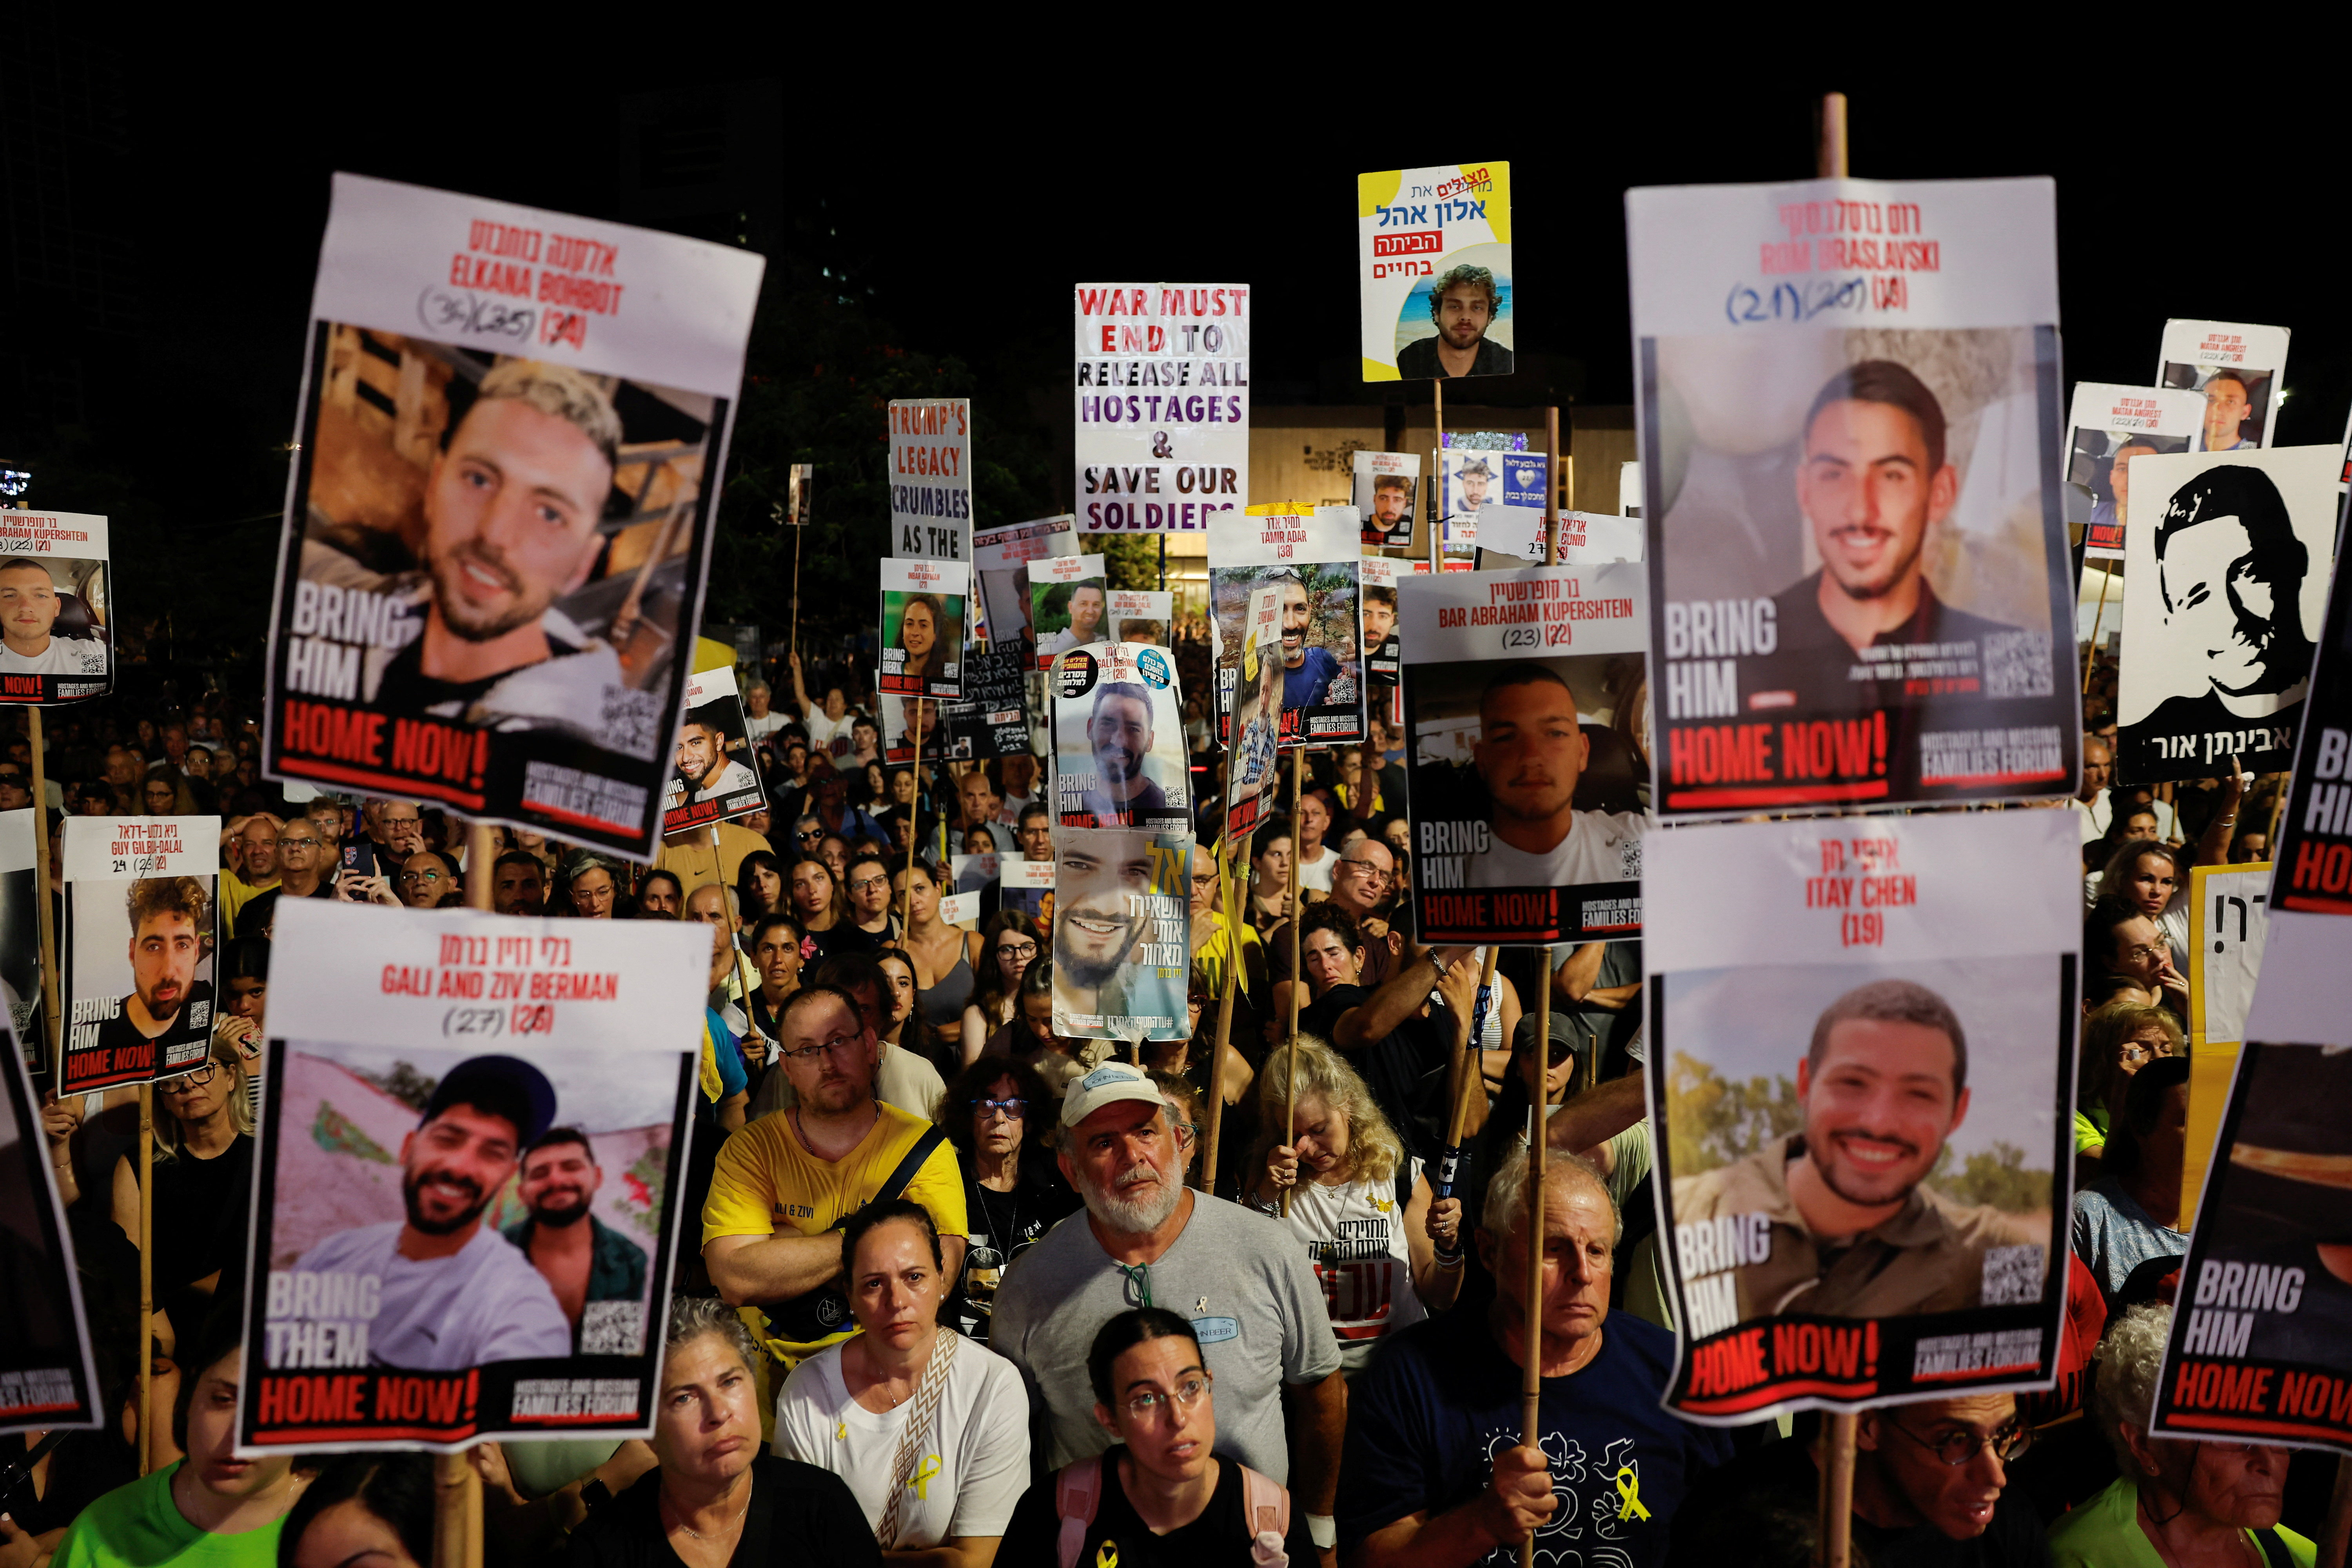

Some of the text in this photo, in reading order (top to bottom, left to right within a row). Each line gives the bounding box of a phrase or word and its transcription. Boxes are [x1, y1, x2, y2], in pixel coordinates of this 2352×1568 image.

[1437, 167, 1490, 197] מצילים
[1376, 199, 1486, 228] אלון אהל
[1378, 235, 1437, 253] הביתה
[1760, 240, 1939, 274] ROM BRASLAVSKI
[1374, 261, 1433, 278] בחיים
[450, 254, 625, 317] ELKANA BOHBOT
[1079, 289, 1246, 316] WAR MUST
[1102, 325, 1223, 352] END TO
[1078, 362, 1247, 386] RELEASE ALL
[890, 402, 966, 436] TRUMP'S
[1083, 395, 1241, 423] HOSTAGES
[1153, 431, 1173, 458] &
[898, 446, 960, 476] LEGACY
[1085, 466, 1237, 493] SAVE OUR
[892, 485, 969, 520] CRUMBLES
[3, 515, 57, 528] בר קופרשטיין
[34, 529, 88, 541] KUPERSHTEIN
[1265, 517, 1300, 530] תמיר אדר
[1562, 518, 1587, 533] אריאל
[2092, 524, 2122, 543] NOW!
[903, 525, 958, 558] AS THE
[1261, 530, 1307, 544] TAMIR ADAR
[1528, 543, 1546, 554] 27
[1561, 533, 1586, 547] CUNIO
[1278, 544, 1293, 559] (38)
[1490, 578, 1580, 605] בר קופרשטיין
[290, 579, 410, 649] BRING
[1439, 598, 1633, 628] BAR ABRAHAM KUPERSHTEIN
[1037, 632, 1057, 644] BRING
[1502, 628, 1541, 650] (23)
[1665, 596, 1778, 659] BRING
[883, 648, 905, 662] BRING
[997, 641, 1022, 653] GUY
[1142, 655, 1156, 666] כולם
[285, 637, 361, 701] HIM
[882, 661, 897, 674] HER
[1058, 670, 1087, 679] מסרבים
[1097, 659, 1112, 668] GALI
[1113, 668, 1127, 679] (26)
[1142, 669, 1164, 683] עכשיו!
[1144, 663, 1164, 676] בהסכם
[4, 675, 43, 695] NOW!
[687, 686, 703, 697] DAVID
[882, 675, 923, 691] HOME NOW!
[1666, 660, 1739, 719] HIM
[1310, 721, 1358, 734] FAMILIES FORUM
[283, 699, 388, 768] HOME
[392, 716, 490, 791] NOW!
[1669, 710, 1888, 784] HOME NOW!
[2151, 735, 2196, 760] אור
[2203, 727, 2292, 766] אבינתן
[1059, 773, 1096, 792] BRING
[1060, 793, 1083, 812] HIM
[111, 840, 129, 855] GUY
[1420, 820, 1490, 855] BRING
[1145, 841, 1187, 896] אל
[1422, 856, 1465, 889] HIM
[1806, 875, 1917, 909] ITAY CHEN
[1129, 894, 1184, 919] תשאירו
[1424, 888, 1559, 927] HOME NOW!
[1153, 919, 1183, 943] אותי
[1841, 911, 1884, 949] (19)
[1140, 942, 1183, 966] מאחור
[381, 964, 620, 1002] GALI AND ZIV BERMAN
[1157, 968, 1183, 979] זיו ברמן
[71, 995, 121, 1025] BRING
[441, 1006, 506, 1038] (27)
[69, 1022, 101, 1051] HIM
[67, 1048, 110, 1080] HOME
[114, 1039, 156, 1075] NOW!
[1089, 1074, 1111, 1086] JOHN
[789, 1204, 795, 1216] &
[797, 1205, 813, 1219] ZIVI
[1338, 1218, 1389, 1240] מחזירים
[1356, 1239, 1392, 1259] אותם
[1674, 1211, 1772, 1281] BRING
[265, 1270, 382, 1321] BRING
[2195, 1258, 2305, 1314] BRING
[1681, 1271, 1739, 1342] HIM
[265, 1321, 370, 1370] THEM
[2183, 1308, 2254, 1359] HIM
[1690, 1319, 1879, 1397] HOME NOW!
[258, 1368, 481, 1425] HOME NOW!
